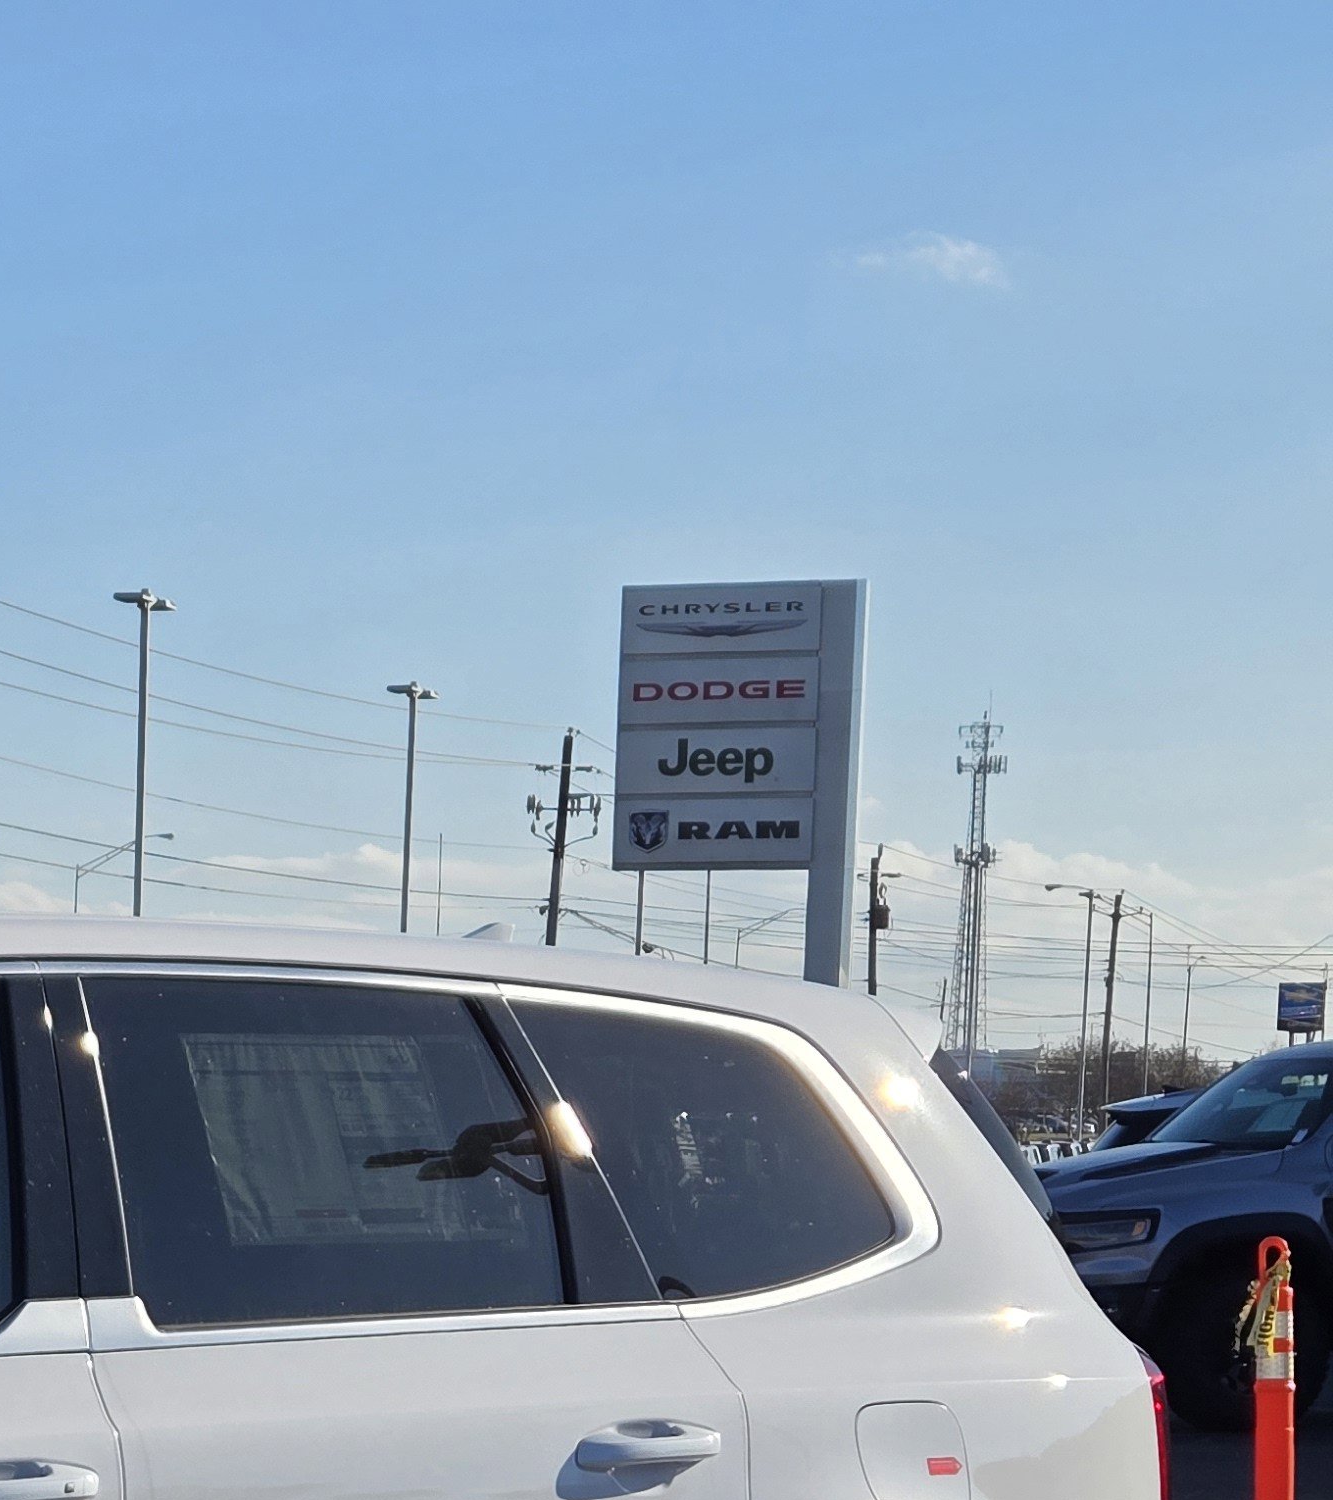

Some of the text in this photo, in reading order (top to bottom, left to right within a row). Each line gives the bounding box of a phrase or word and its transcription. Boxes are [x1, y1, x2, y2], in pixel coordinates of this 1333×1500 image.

[638, 600, 805, 617] CHRYSLER
[632, 679, 807, 703] DODGE
[657, 737, 774, 784] Jeep
[676, 819, 801, 841] RAM
